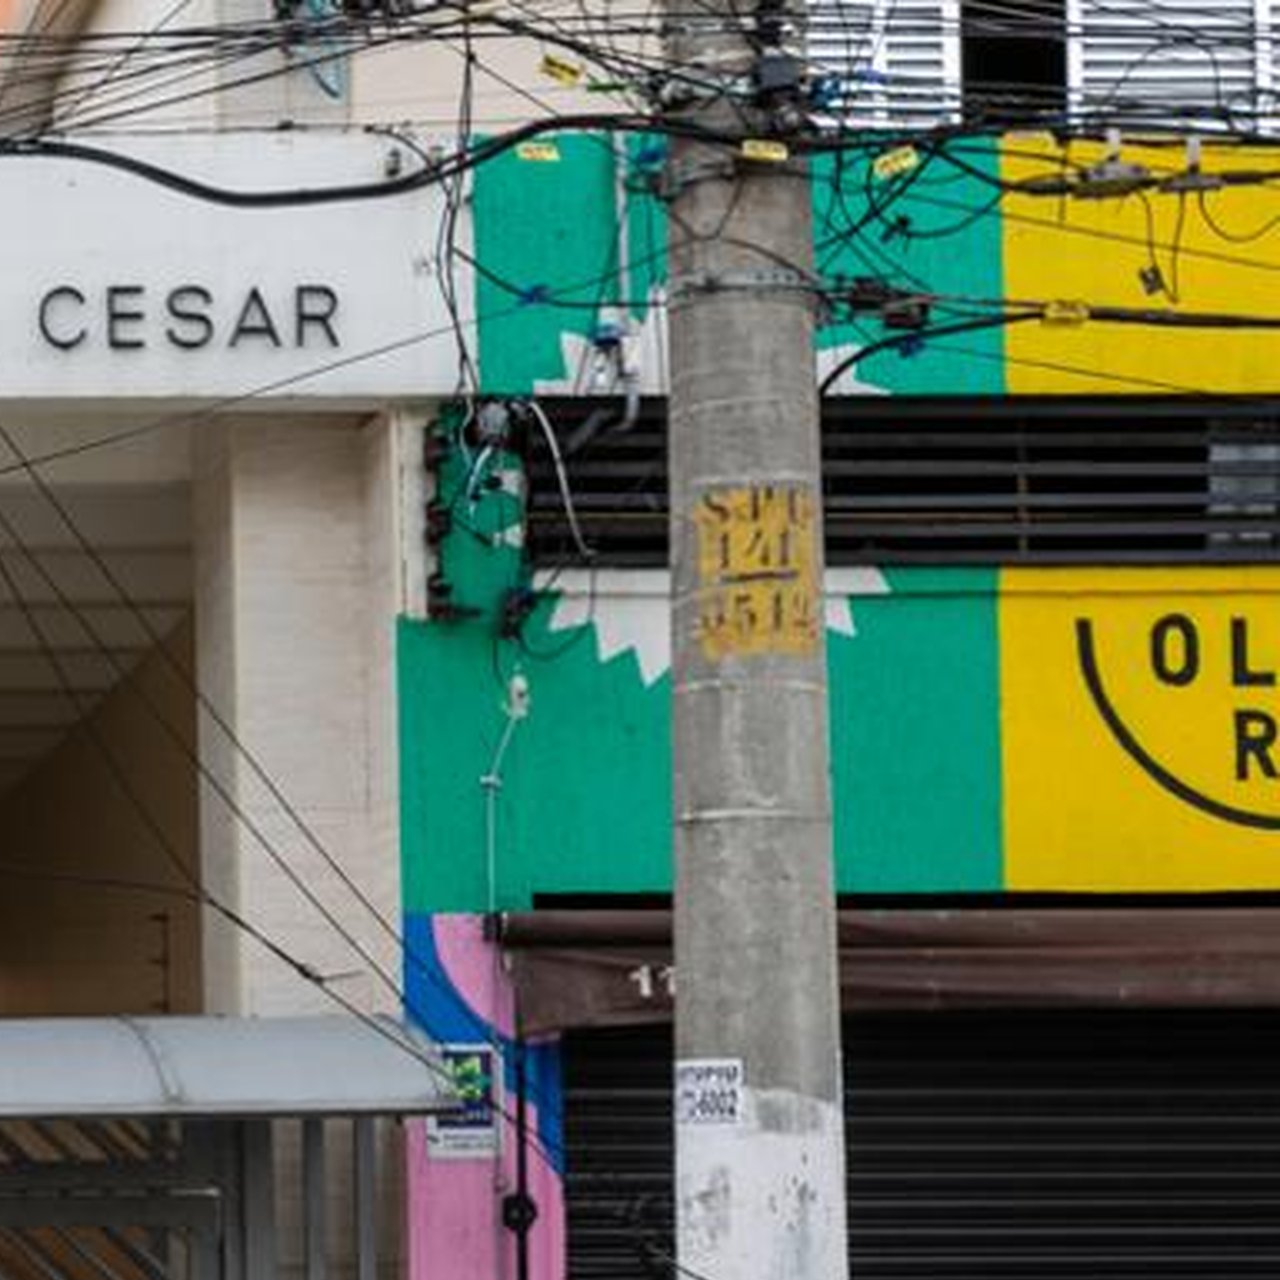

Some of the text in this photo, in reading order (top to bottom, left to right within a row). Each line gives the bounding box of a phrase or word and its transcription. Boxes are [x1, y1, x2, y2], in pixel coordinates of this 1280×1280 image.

[38, 285, 341, 351] CESAR
[1151, 612, 1276, 687] OL
[1236, 708, 1280, 781] R
